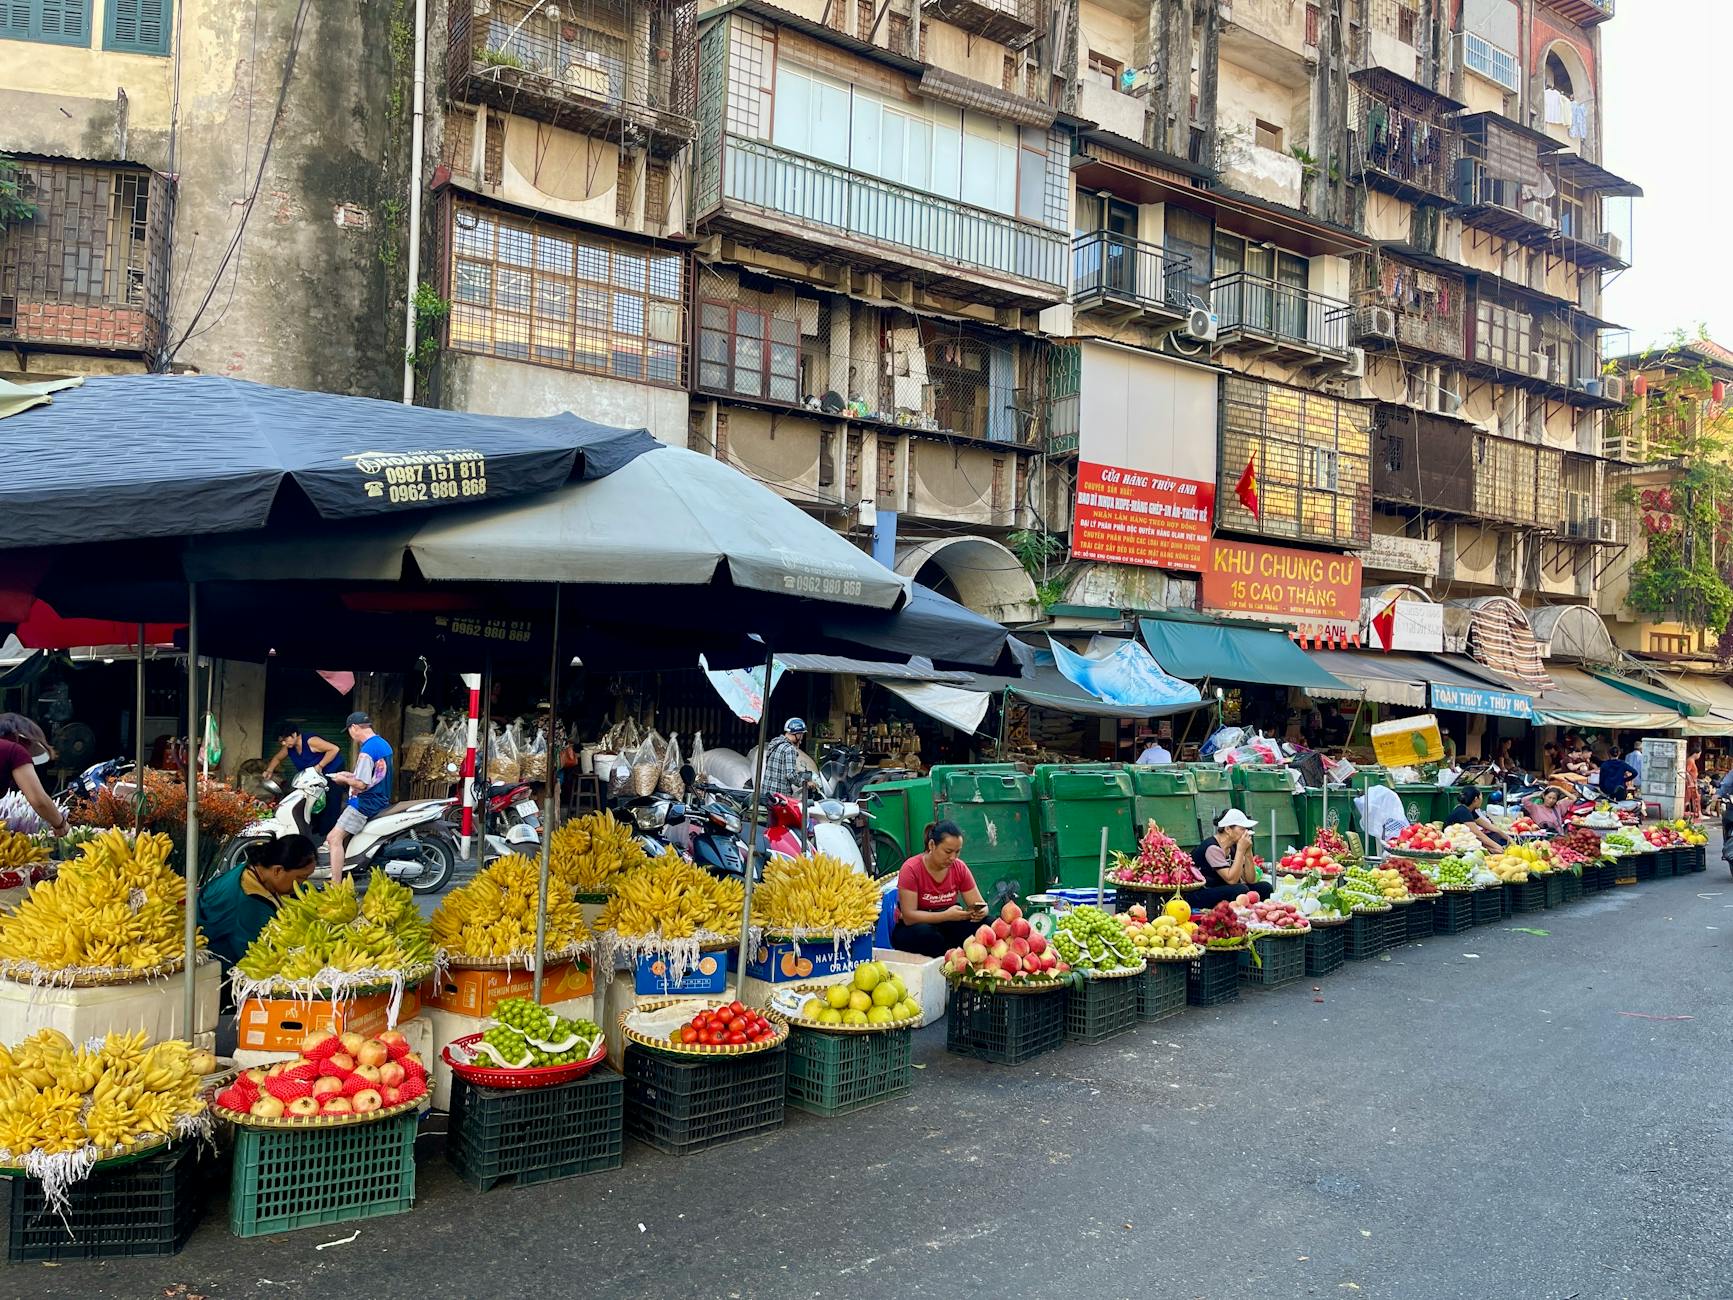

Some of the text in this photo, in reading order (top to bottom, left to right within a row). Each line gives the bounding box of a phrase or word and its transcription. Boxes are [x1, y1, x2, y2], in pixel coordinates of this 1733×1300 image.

[385, 460, 485, 484] 0987 151 811
[1101, 468, 1120, 483] CỬA
[1177, 484, 1198, 496] ANH
[389, 477, 487, 503] 0962 980 868
[1213, 547, 1255, 575] KHU
[1260, 553, 1324, 583] CHUNG
[1328, 560, 1354, 586] CƯ
[796, 575, 862, 597] 0962 980 868
[1231, 580, 1337, 607] 15 CAO THẮNG
[451, 621, 481, 637] 0962
[483, 626, 506, 640] 980
[815, 951, 845, 964] NAVEL
